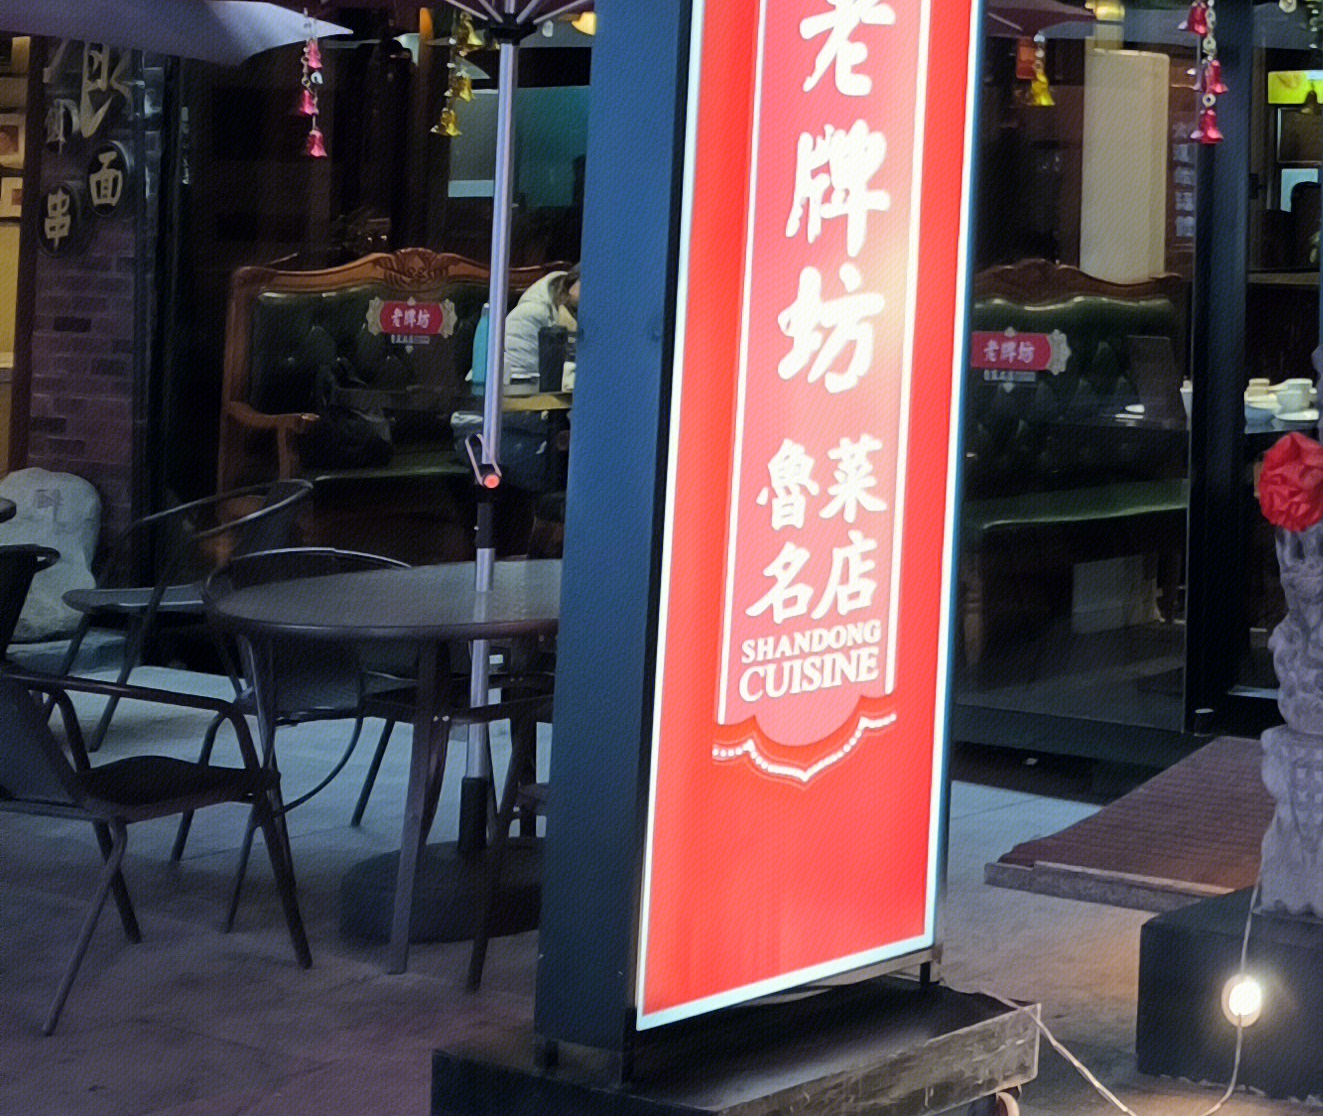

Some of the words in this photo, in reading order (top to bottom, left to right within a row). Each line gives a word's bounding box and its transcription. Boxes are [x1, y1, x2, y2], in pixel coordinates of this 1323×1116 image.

[745, 529, 878, 625] 名店
[741, 619, 882, 664] SHANDONG
[739, 646, 880, 702] CUISINE
